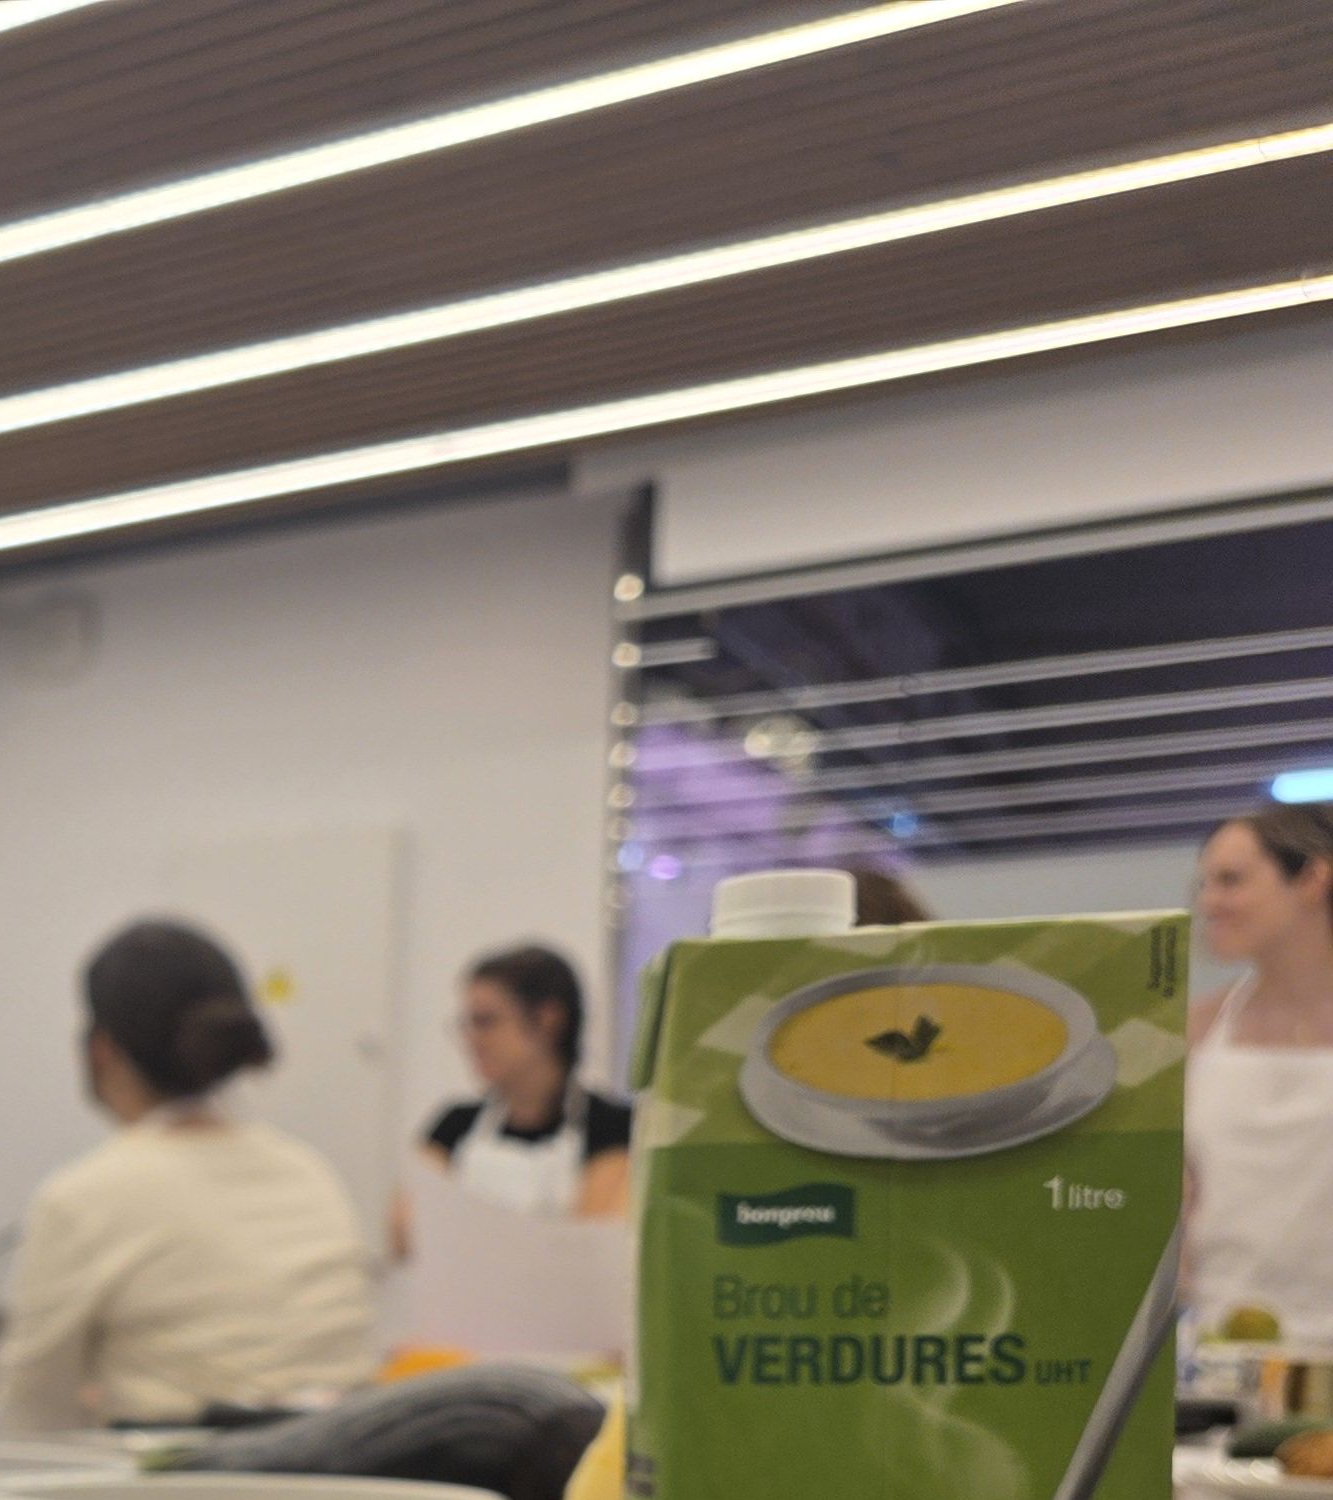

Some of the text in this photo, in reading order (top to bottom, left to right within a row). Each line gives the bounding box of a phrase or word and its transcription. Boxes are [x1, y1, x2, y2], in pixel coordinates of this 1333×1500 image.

[1043, 1175, 1126, 1211] 1 litre
[713, 1273, 891, 1320] Brou de
[712, 1332, 1092, 1387] VERDURES UHT
